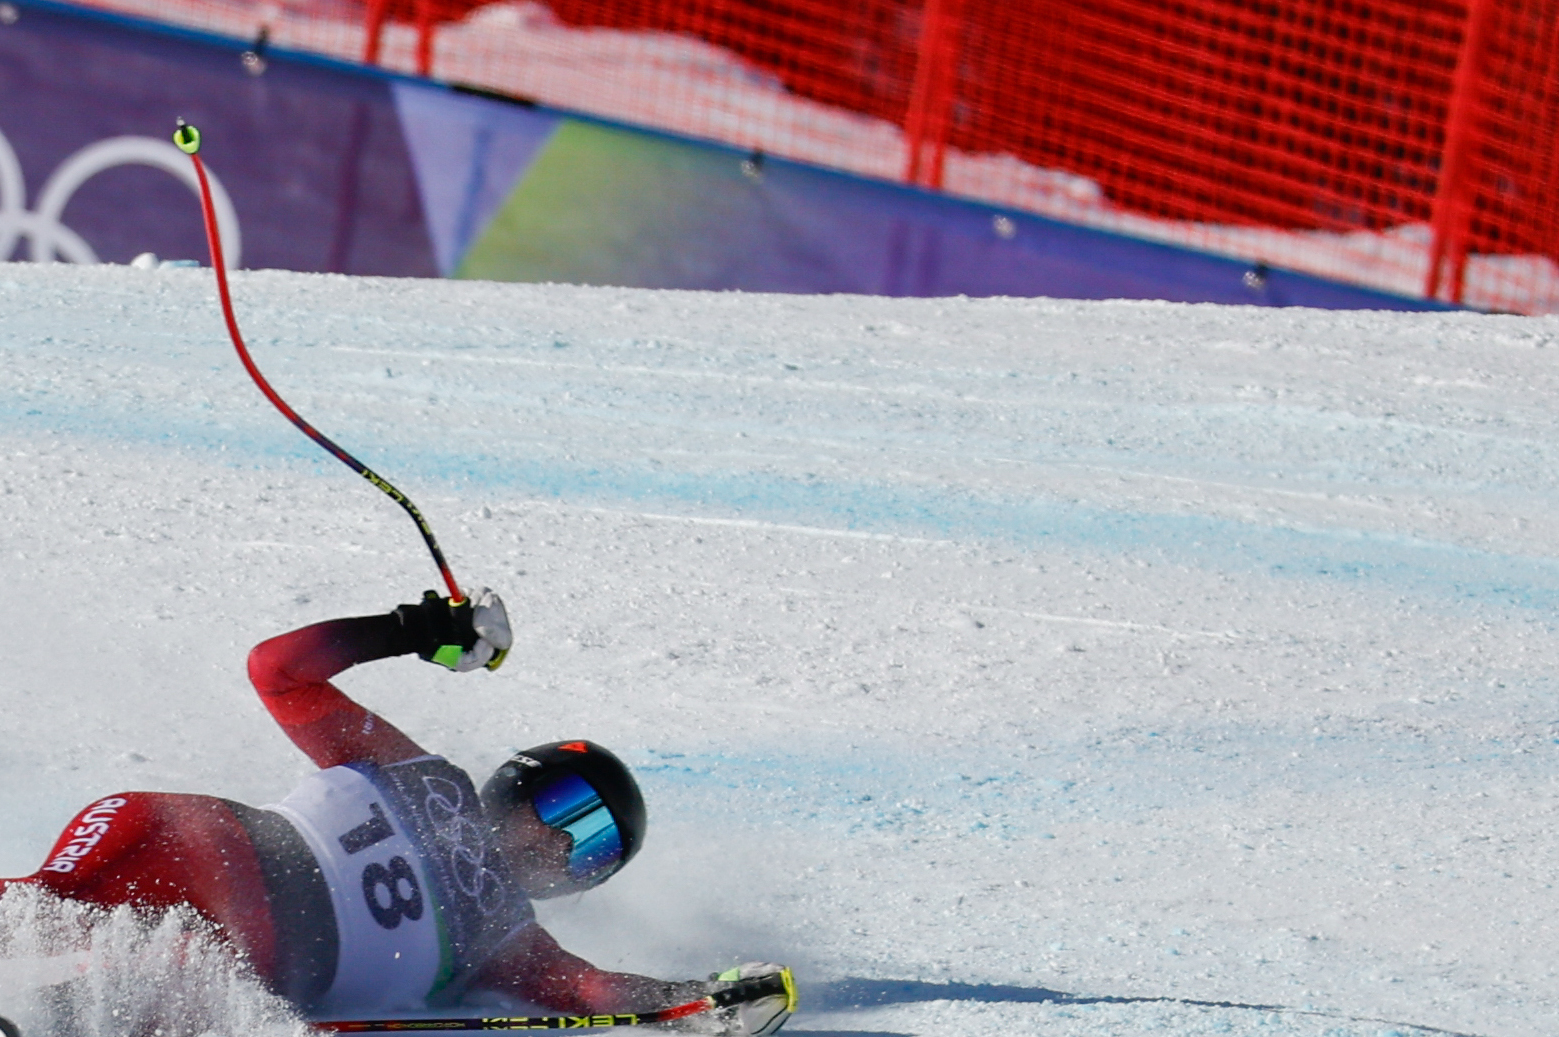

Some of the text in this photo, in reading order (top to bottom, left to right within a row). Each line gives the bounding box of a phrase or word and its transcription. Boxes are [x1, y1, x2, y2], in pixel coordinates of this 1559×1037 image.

[42, 797, 127, 873] AUSTRIA
[338, 801, 424, 931] 18
[558, 1013, 639, 1029] LEKI
